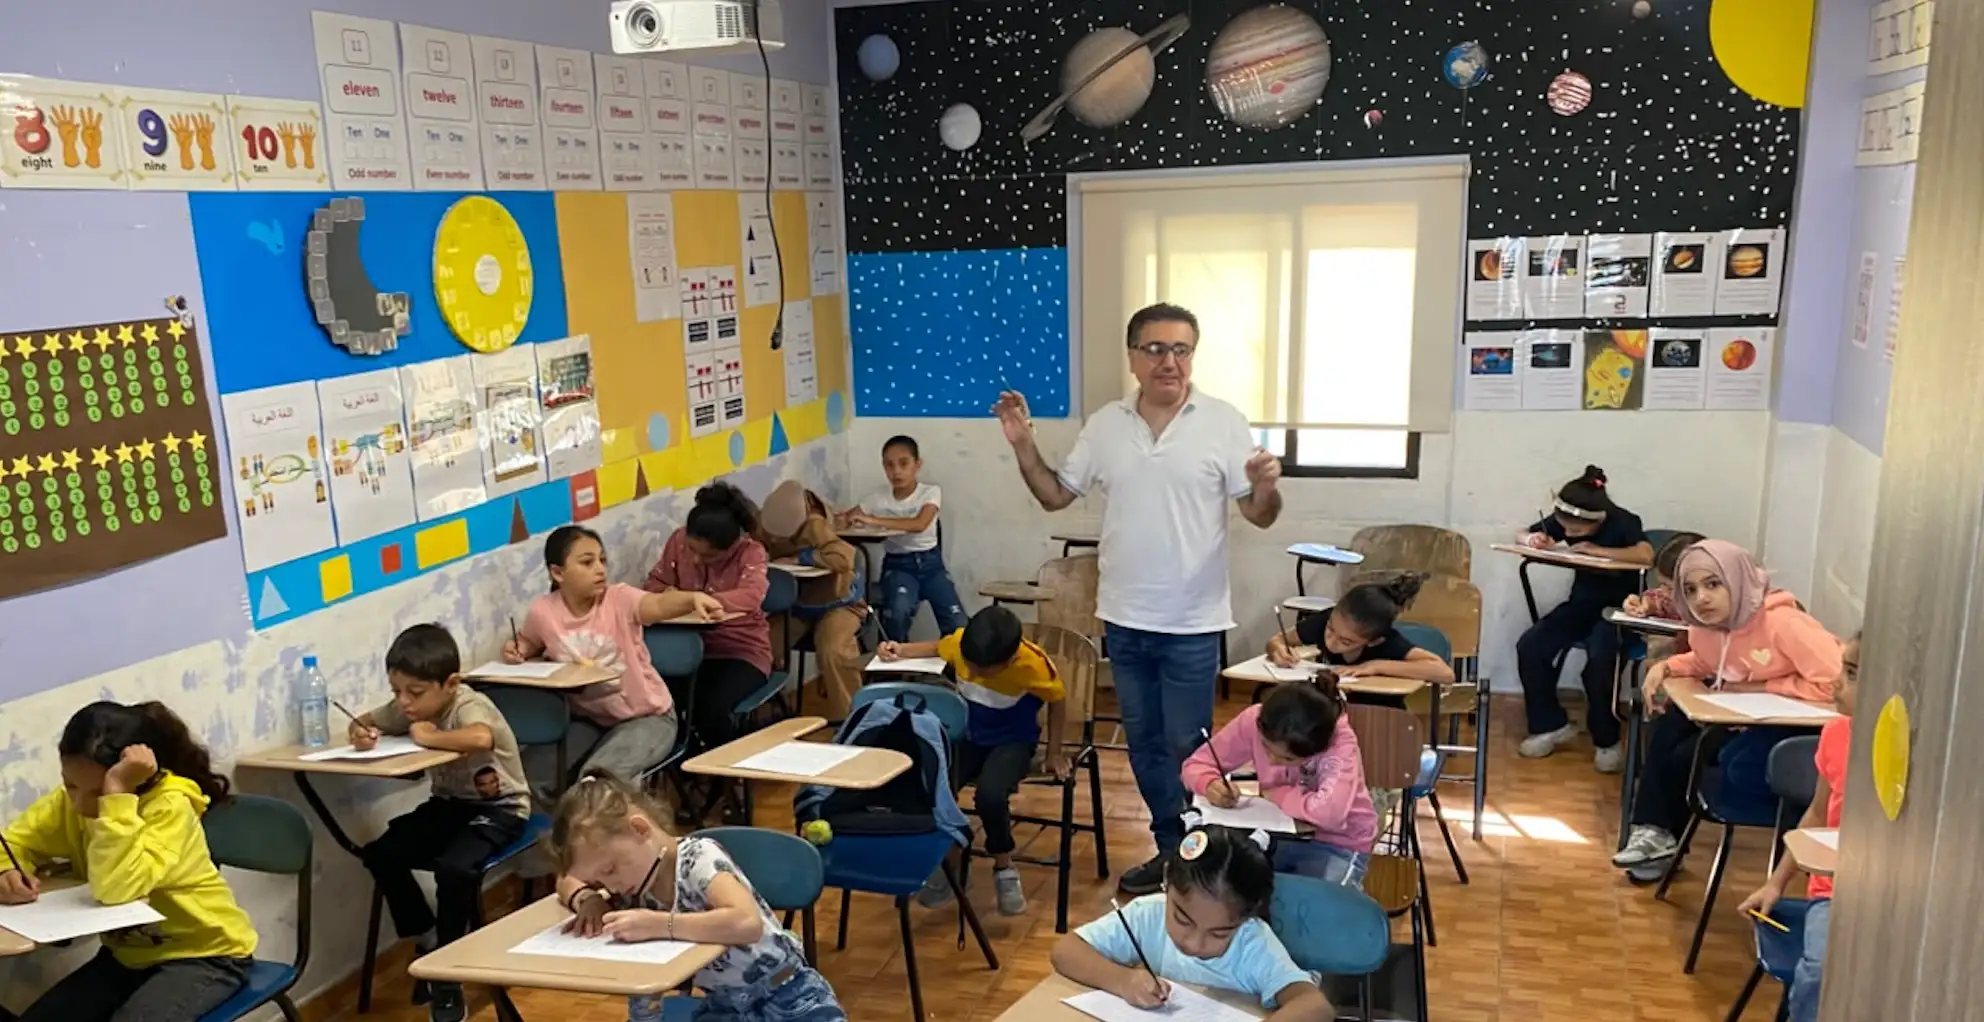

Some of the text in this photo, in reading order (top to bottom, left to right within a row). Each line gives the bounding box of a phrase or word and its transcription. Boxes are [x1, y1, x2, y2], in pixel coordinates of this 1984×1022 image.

[342, 81, 380, 97] eleven
[423, 88, 457, 104] twelve
[490, 95, 525, 110] thirteen
[15, 104, 51, 155] 8
[137, 108, 168, 158] 9
[346, 126, 391, 139] Ten One
[426, 130, 440, 140] Ten
[241, 124, 279, 161] 10
[21, 156, 54, 171] eight
[144, 161, 168, 172] nine
[253, 164, 269, 173] ten
[348, 168, 397, 179] Odd number
[426, 169, 443, 179] Even
[252, 407, 294, 426] اللغة العربية
